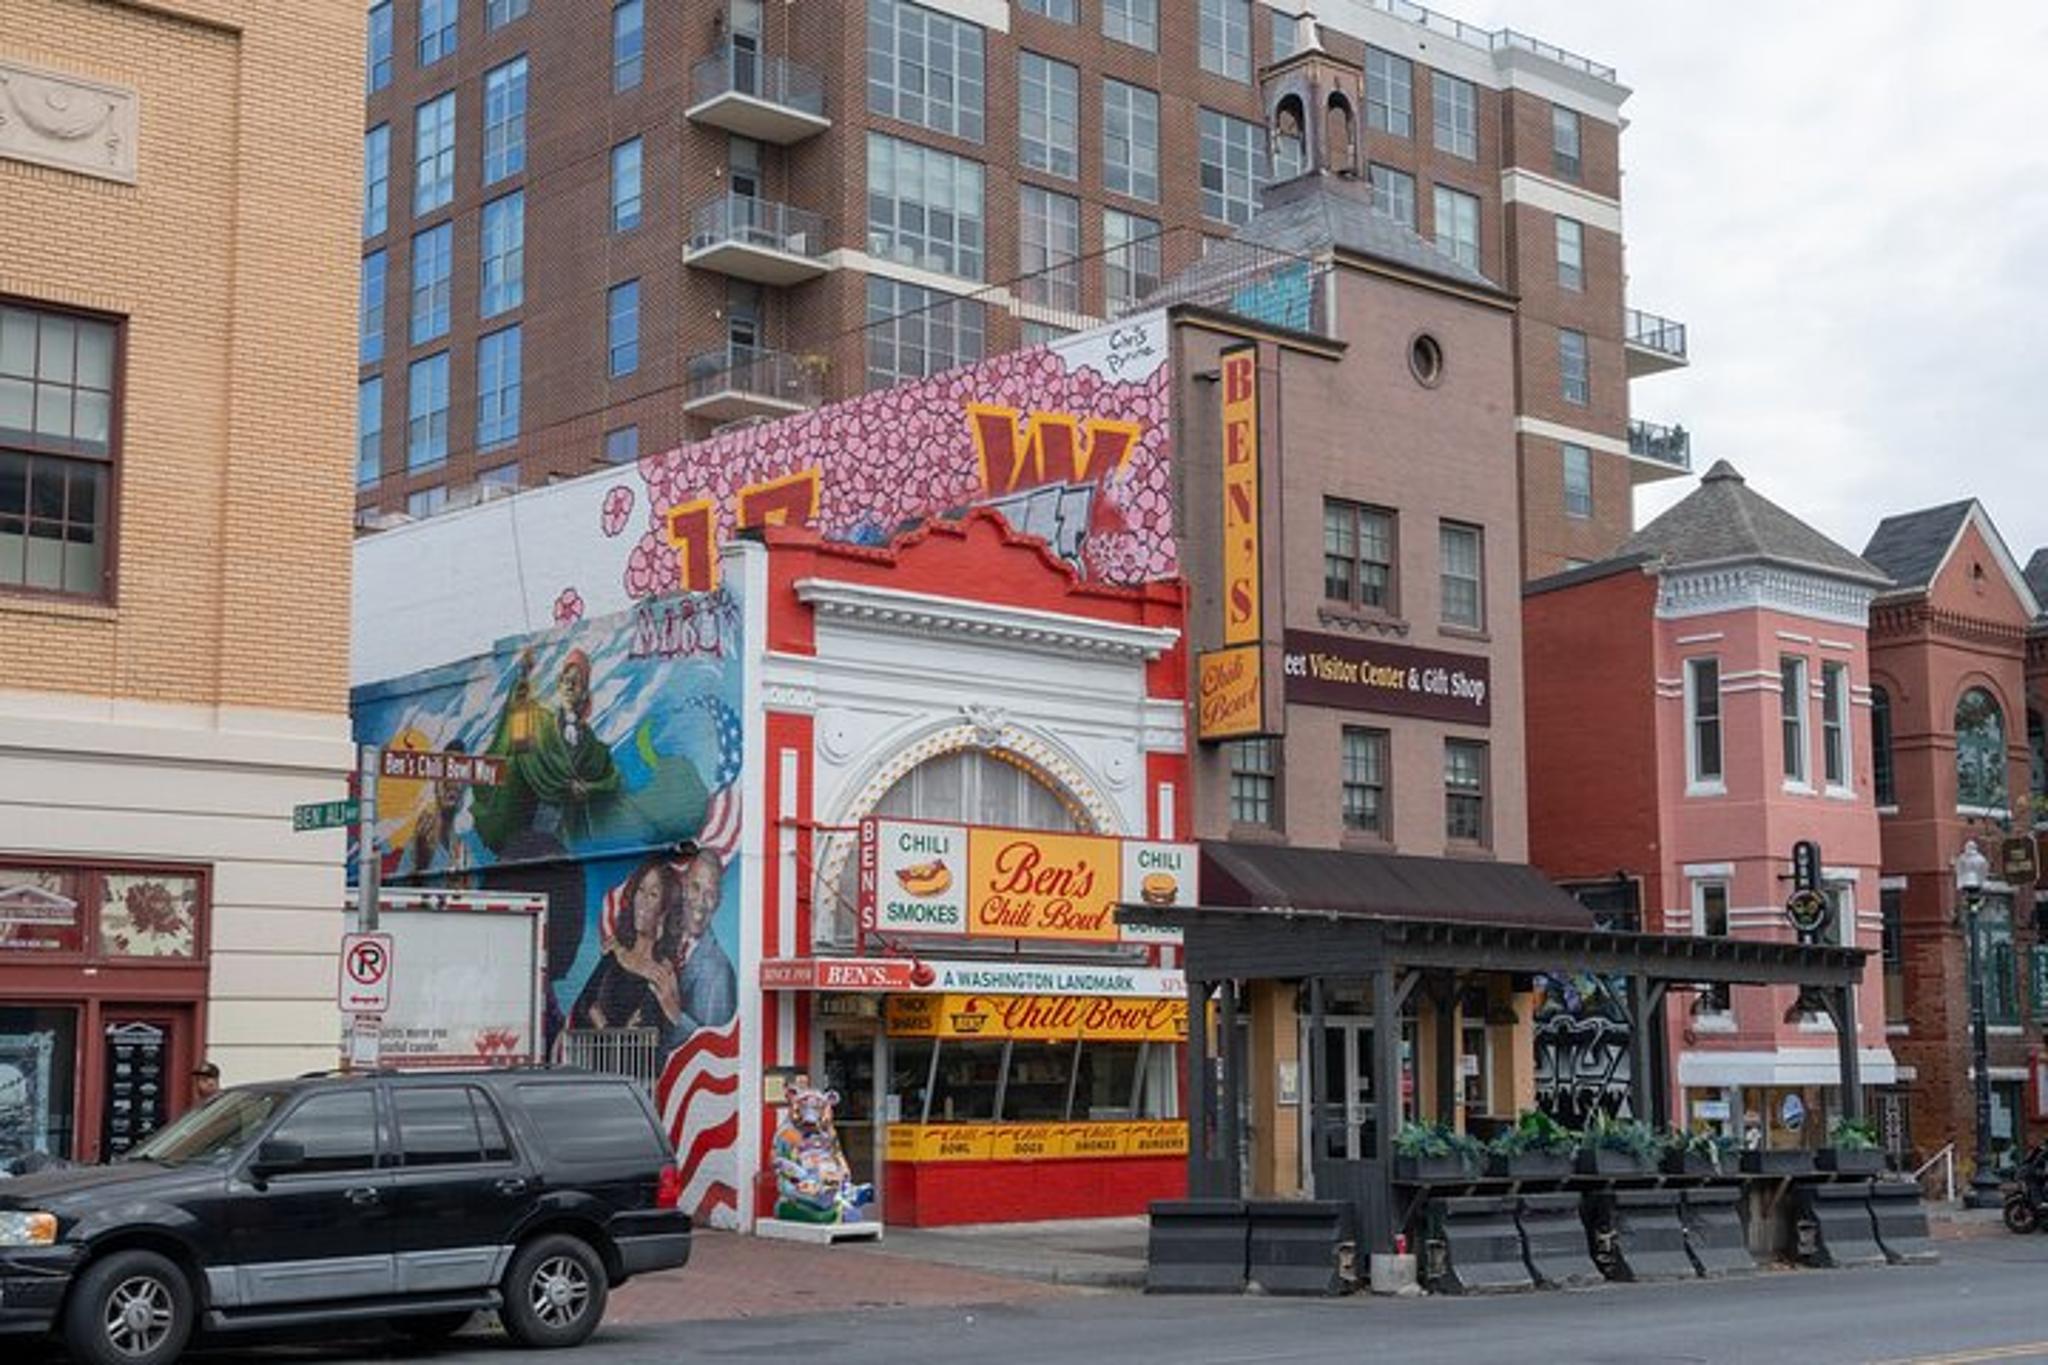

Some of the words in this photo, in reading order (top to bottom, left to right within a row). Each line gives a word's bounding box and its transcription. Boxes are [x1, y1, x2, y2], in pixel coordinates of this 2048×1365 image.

[1226, 358, 1254, 627] BEN'S
[1201, 654, 1244, 697] Chili
[1310, 653, 1358, 684] Visitor
[1360, 661, 1406, 690] Center
[1408, 668, 1420, 692] &
[1422, 668, 1449, 696] Gift
[1452, 671, 1486, 706] Shop
[1202, 676, 1259, 731] Bowl
[386, 752, 414, 776] Ben's
[418, 755, 444, 777] Chili
[446, 758, 473, 780] Bowl
[475, 759, 499, 785] Way
[296, 806, 320, 829] BEN
[899, 832, 950, 854] CHILI
[1138, 850, 1182, 870] CHILI
[861, 821, 876, 930] BEN'S
[989, 841, 1096, 899] Ben's
[887, 902, 959, 925] SMOKES
[979, 895, 1036, 928] Chili
[1037, 899, 1117, 932] Bowl
[944, 970, 955, 987] A
[957, 971, 1053, 989] WASHINGTON
[1057, 973, 1135, 991] LANDMARK
[1001, 995, 1081, 1031] Chili
[1083, 995, 1169, 1031] Bowl
